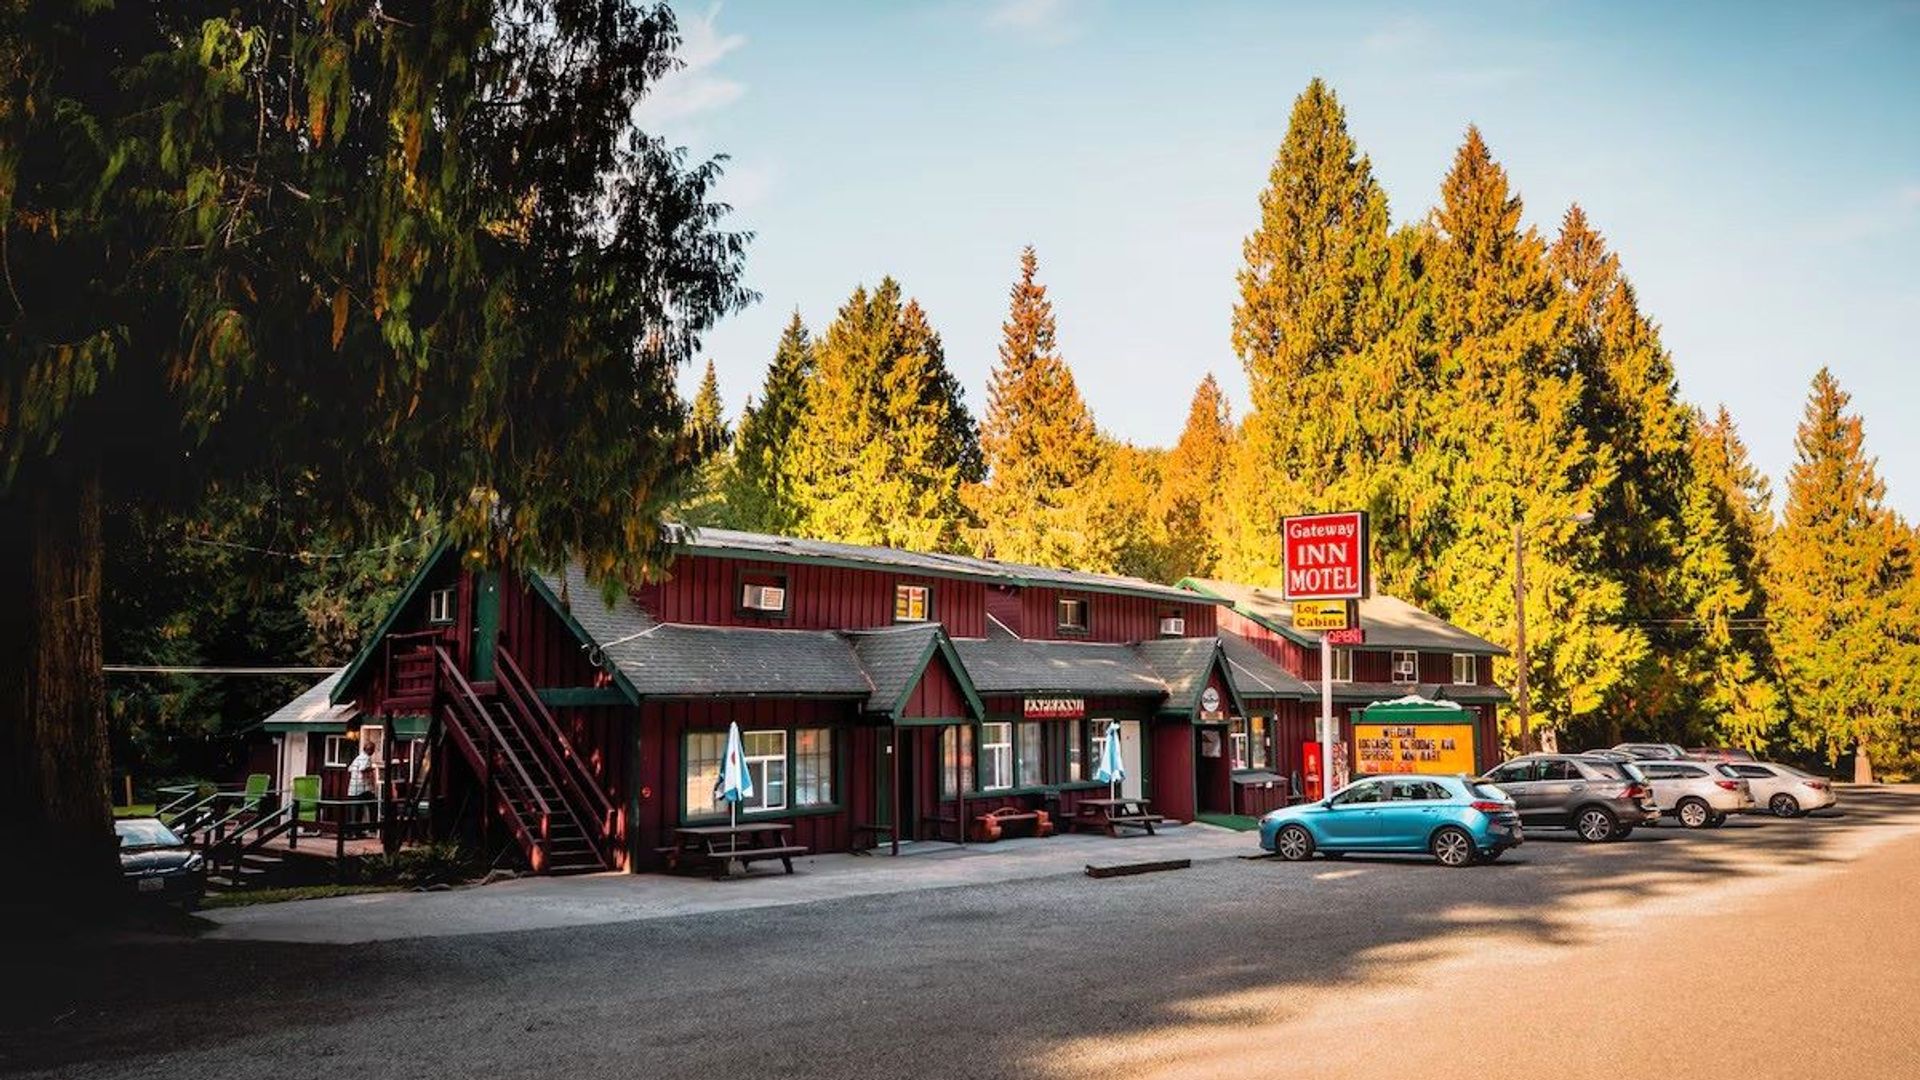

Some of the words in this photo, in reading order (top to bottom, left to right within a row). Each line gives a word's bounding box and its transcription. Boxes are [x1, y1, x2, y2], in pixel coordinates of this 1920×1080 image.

[1290, 523, 1354, 538] Gateway
[1297, 542, 1347, 566] INN
[1290, 567, 1357, 591] MOTEL
[1297, 604, 1318, 615] Log
[1296, 617, 1344, 627] Cabins
[1328, 630, 1361, 642] OPEN
